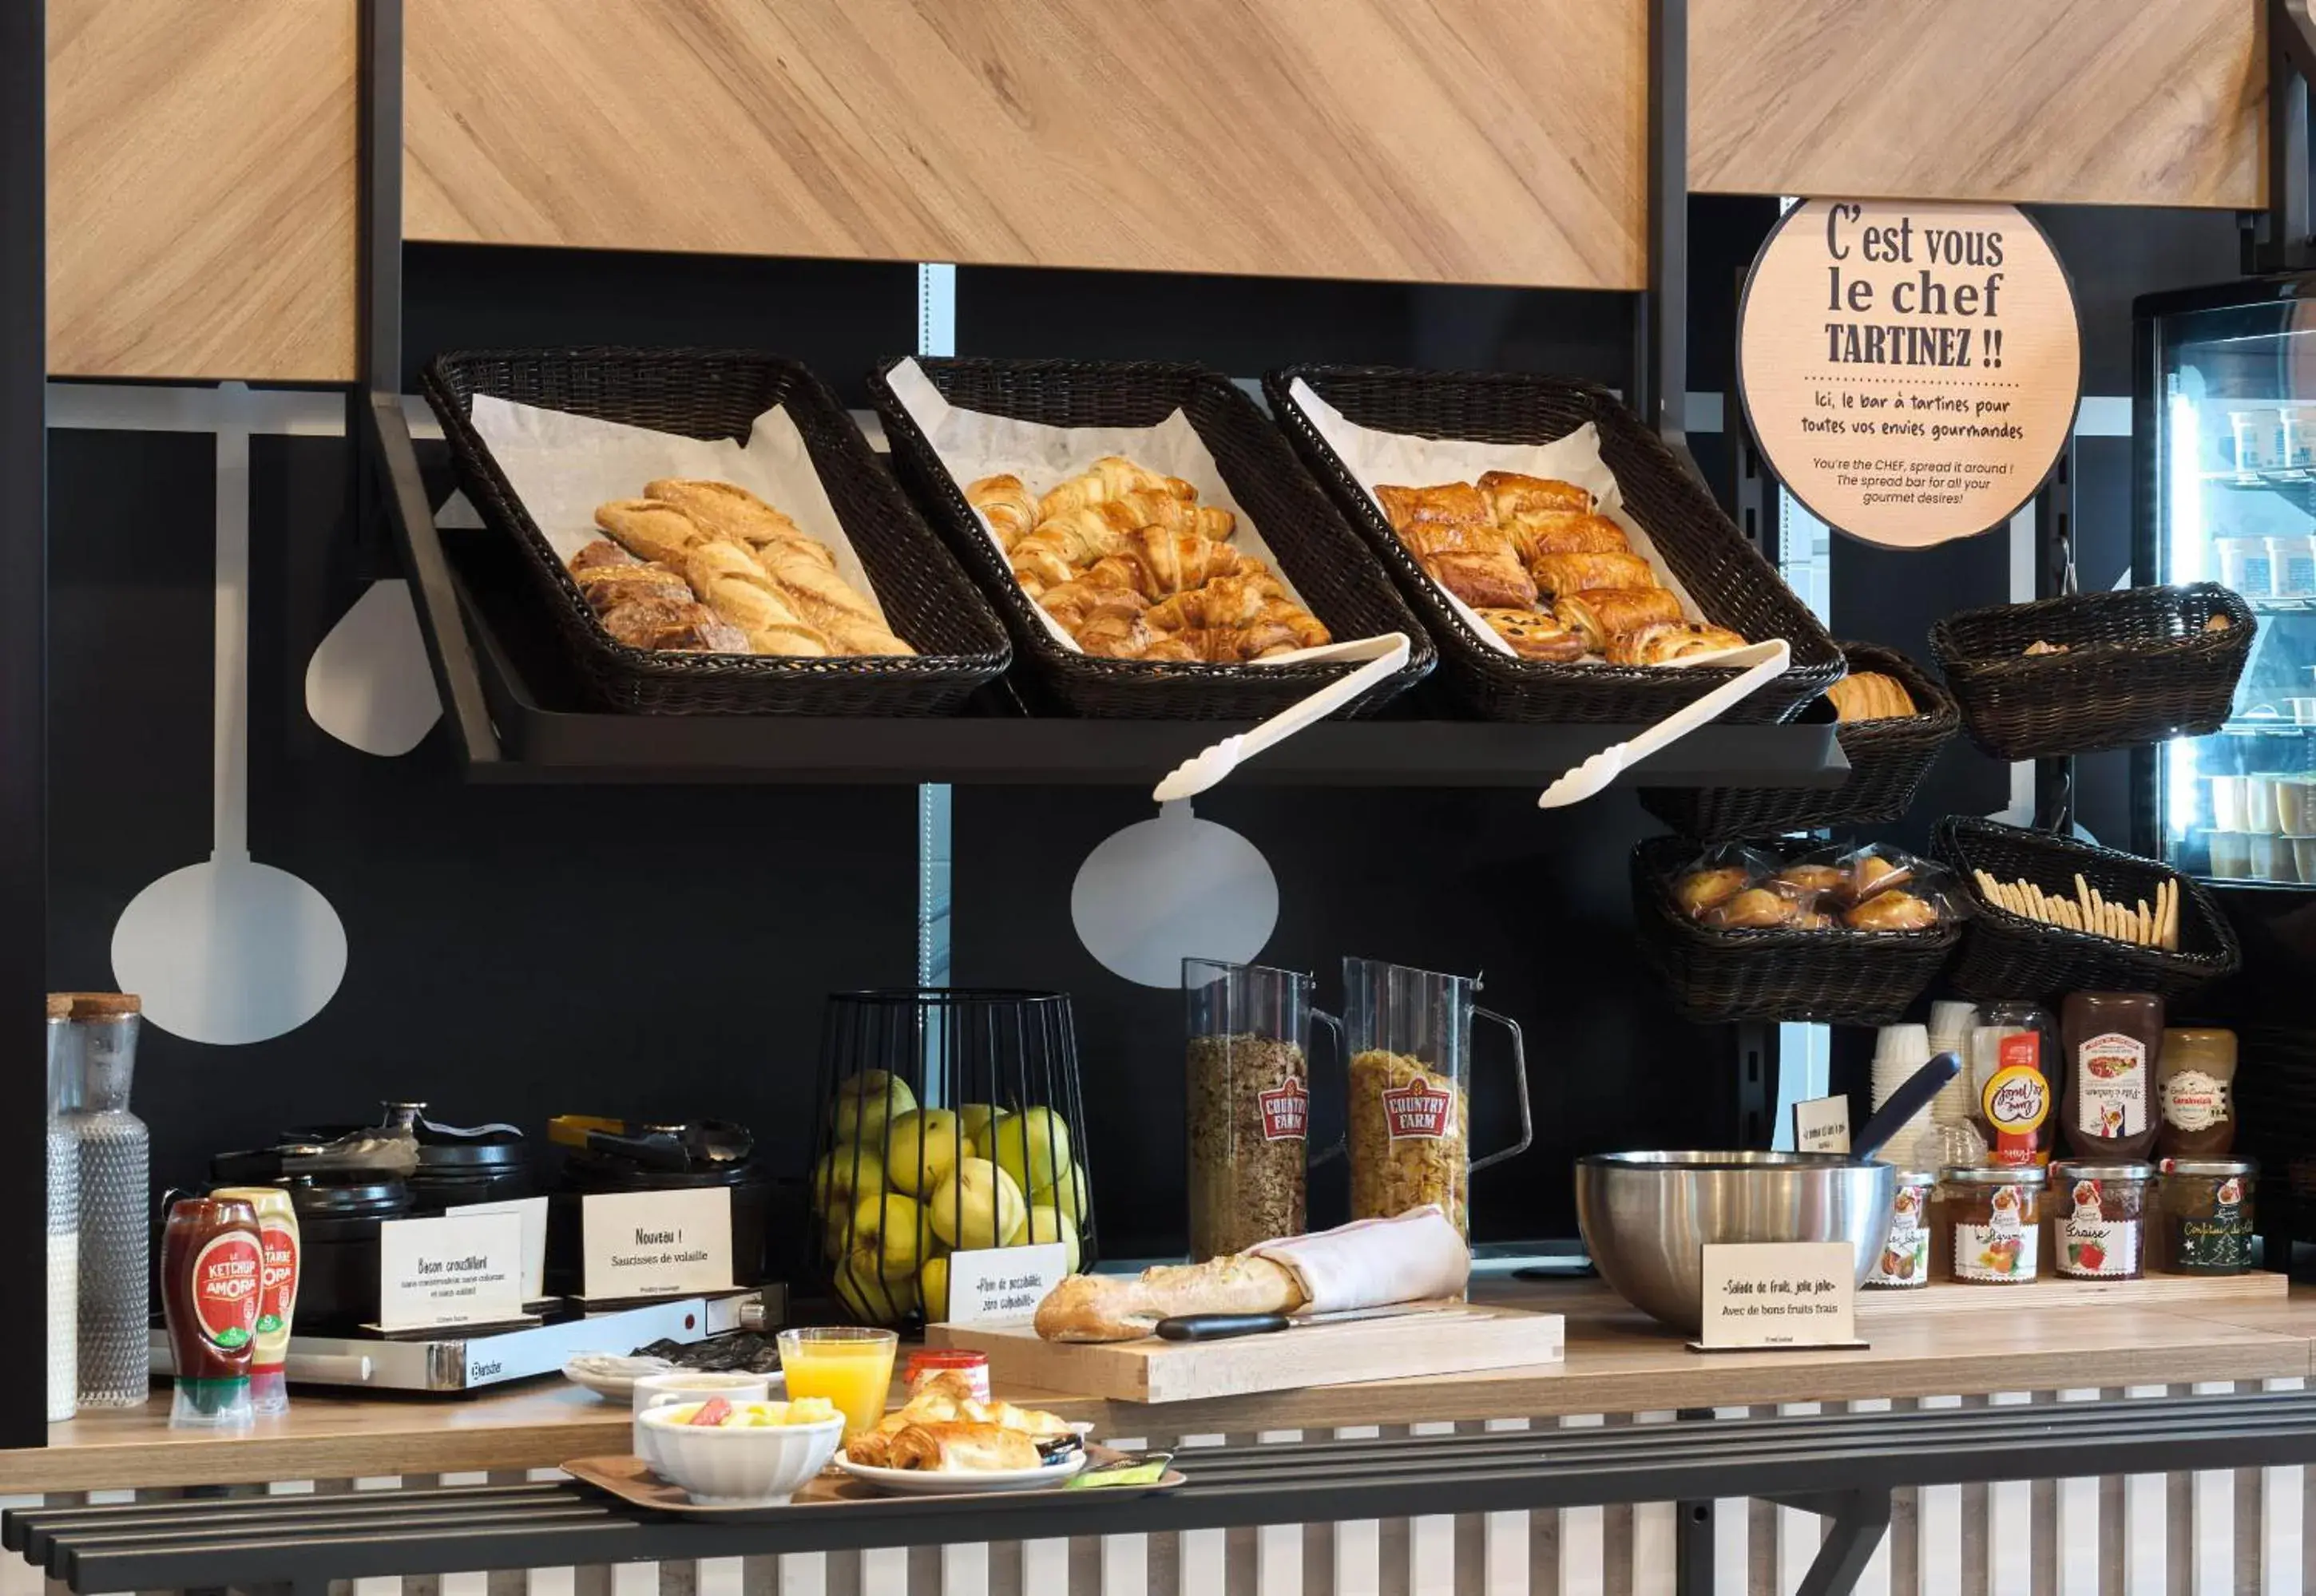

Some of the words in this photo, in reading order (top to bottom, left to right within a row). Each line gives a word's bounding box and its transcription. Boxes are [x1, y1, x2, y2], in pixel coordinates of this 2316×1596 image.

[1925, 229, 2004, 267] vous
[1828, 266, 1874, 312] le
[1892, 270, 2004, 317] chef
[1824, 323, 1972, 366] TARTINEZ
[1982, 328, 2003, 368] !!
[1814, 390, 1835, 409] Ici,
[1842, 391, 1854, 408] le
[1859, 394, 1888, 409] bar
[1894, 390, 1905, 410] à
[1910, 394, 1969, 413] tartines
[1976, 400, 2011, 418] pour
[1801, 416, 1846, 434] toutes
[1852, 421, 1875, 435] vos
[1882, 420, 1925, 436] envies
[1931, 422, 2024, 441] gourmandes
[1813, 457, 1850, 470] You're
[1853, 458, 1872, 470] the
[1876, 460, 1907, 473] CHEF,
[1910, 461, 1952, 474] spread
[1953, 461, 1961, 473] it
[1965, 462, 2007, 474] around
[1836, 475, 1858, 486] The
[1861, 476, 1902, 489] spread
[1906, 476, 1925, 488] bar
[1929, 477, 1945, 488] for
[1947, 477, 1961, 489] all
[1964, 480, 1992, 492] your
[1862, 493, 1915, 505] gourmet
[1917, 493, 1964, 505] desires!
[1389, 1096, 1446, 1115] COUNTRY
[1274, 1114, 1303, 1130] FARM
[1399, 1114, 1437, 1130] FARM
[635, 1228, 674, 1246] Nouveau
[611, 1255, 659, 1267] Saucisses
[660, 1253, 673, 1264] de
[674, 1249, 709, 1263] volaille
[208, 1260, 256, 1279] KETCHUP
[205, 1278, 256, 1298] AMORA
[1756, 1280, 1767, 1294] de
[1722, 1305, 1745, 1317] Avec
[1747, 1304, 1759, 1316] de
[1761, 1304, 1786, 1316] bons
[1787, 1303, 1814, 1315] fruits
[1814, 1303, 1838, 1314] frais
